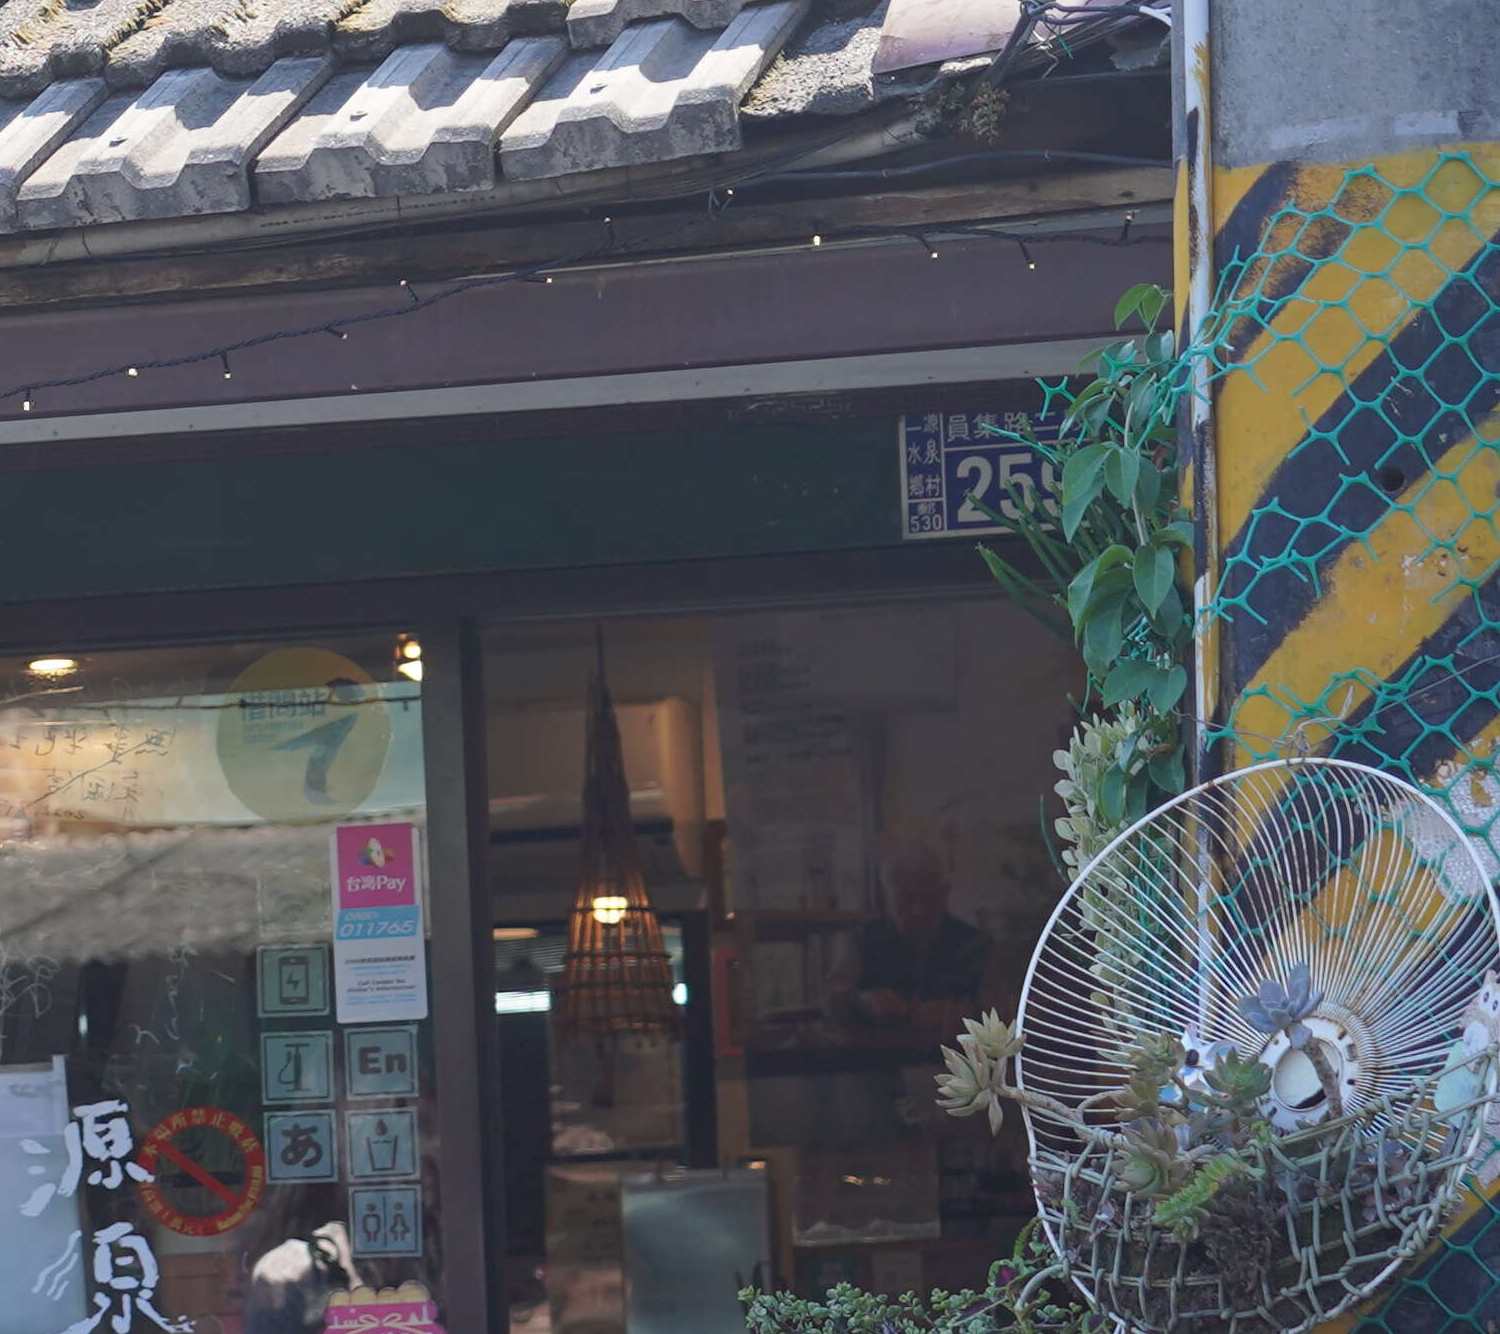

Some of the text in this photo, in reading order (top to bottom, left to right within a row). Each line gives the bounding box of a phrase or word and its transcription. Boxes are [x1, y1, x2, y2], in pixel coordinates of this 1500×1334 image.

[947, 411, 1085, 442] 員集路二
[911, 514, 943, 531] 530
[346, 875, 406, 892] 台灣Pay
[339, 920, 413, 938] 011765
[359, 1046, 408, 1075] En
[280, 1123, 324, 1168] あ
